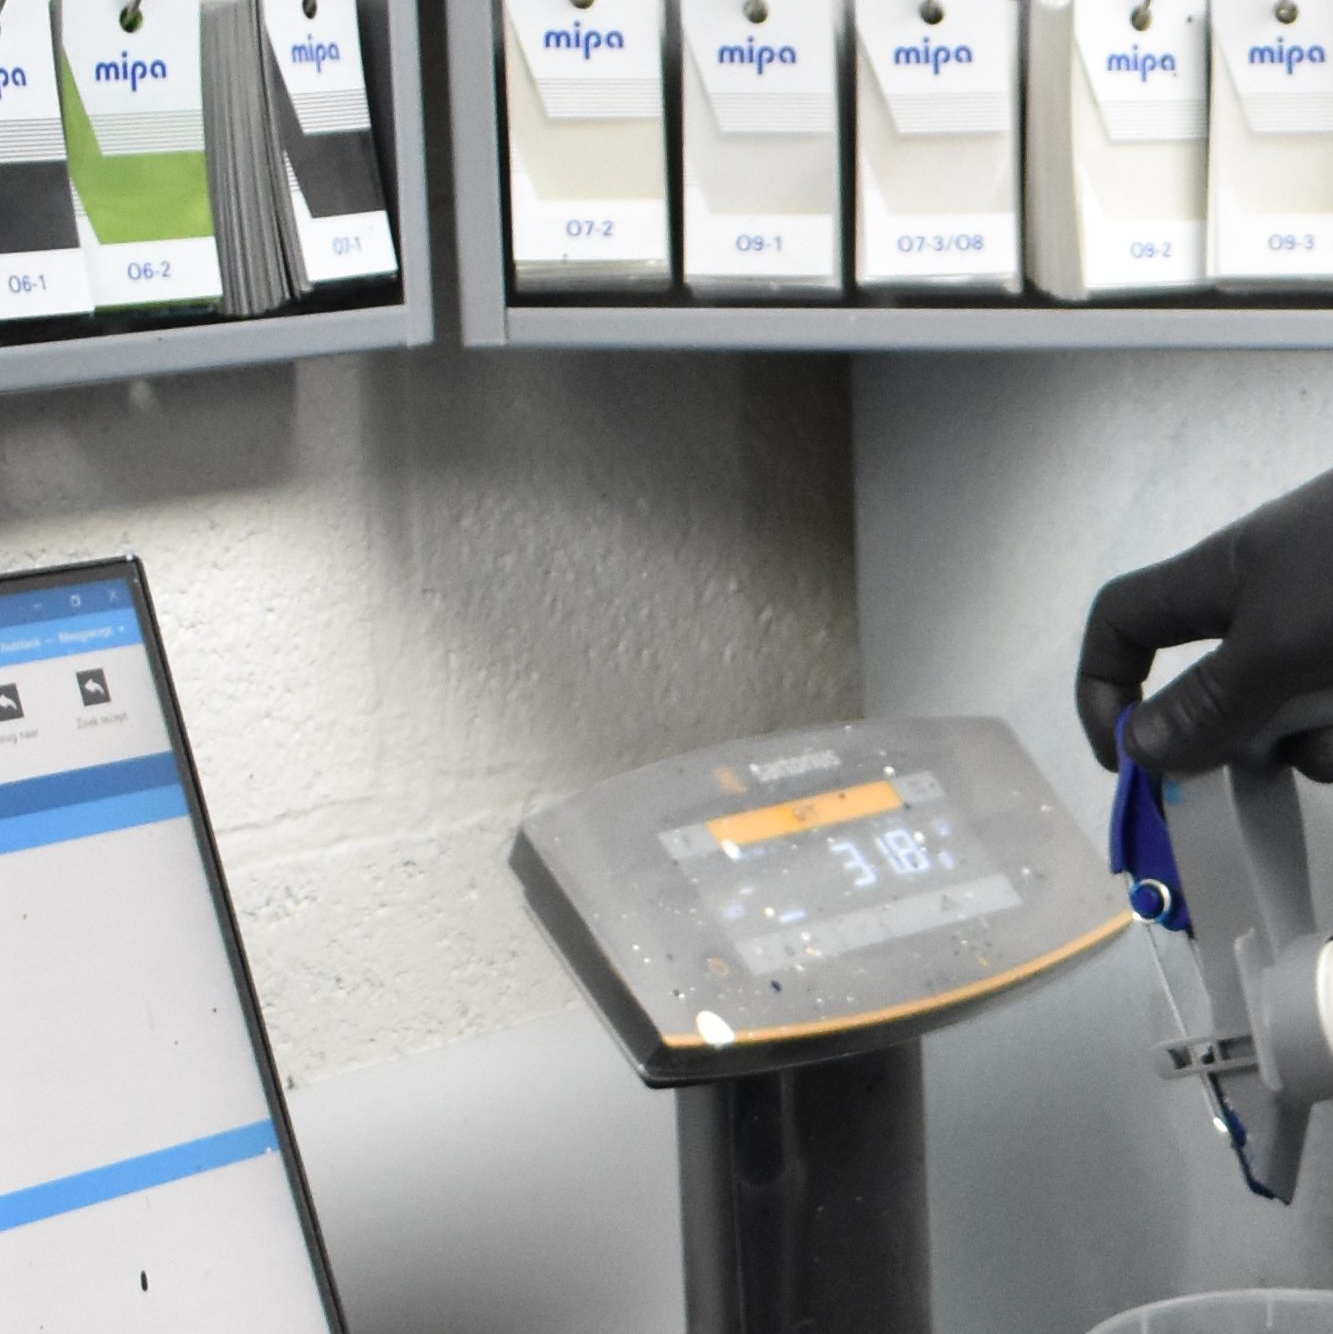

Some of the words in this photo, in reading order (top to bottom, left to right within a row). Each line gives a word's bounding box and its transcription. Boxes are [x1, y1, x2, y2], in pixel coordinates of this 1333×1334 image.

[290, 42, 339, 71] mipa
[543, 22, 623, 59] mipa
[716, 37, 796, 74] mipa
[892, 37, 972, 74] mipa
[1248, 39, 1325, 73] mipa
[94, 51, 167, 91] mipa
[1106, 44, 1176, 82] mipa
